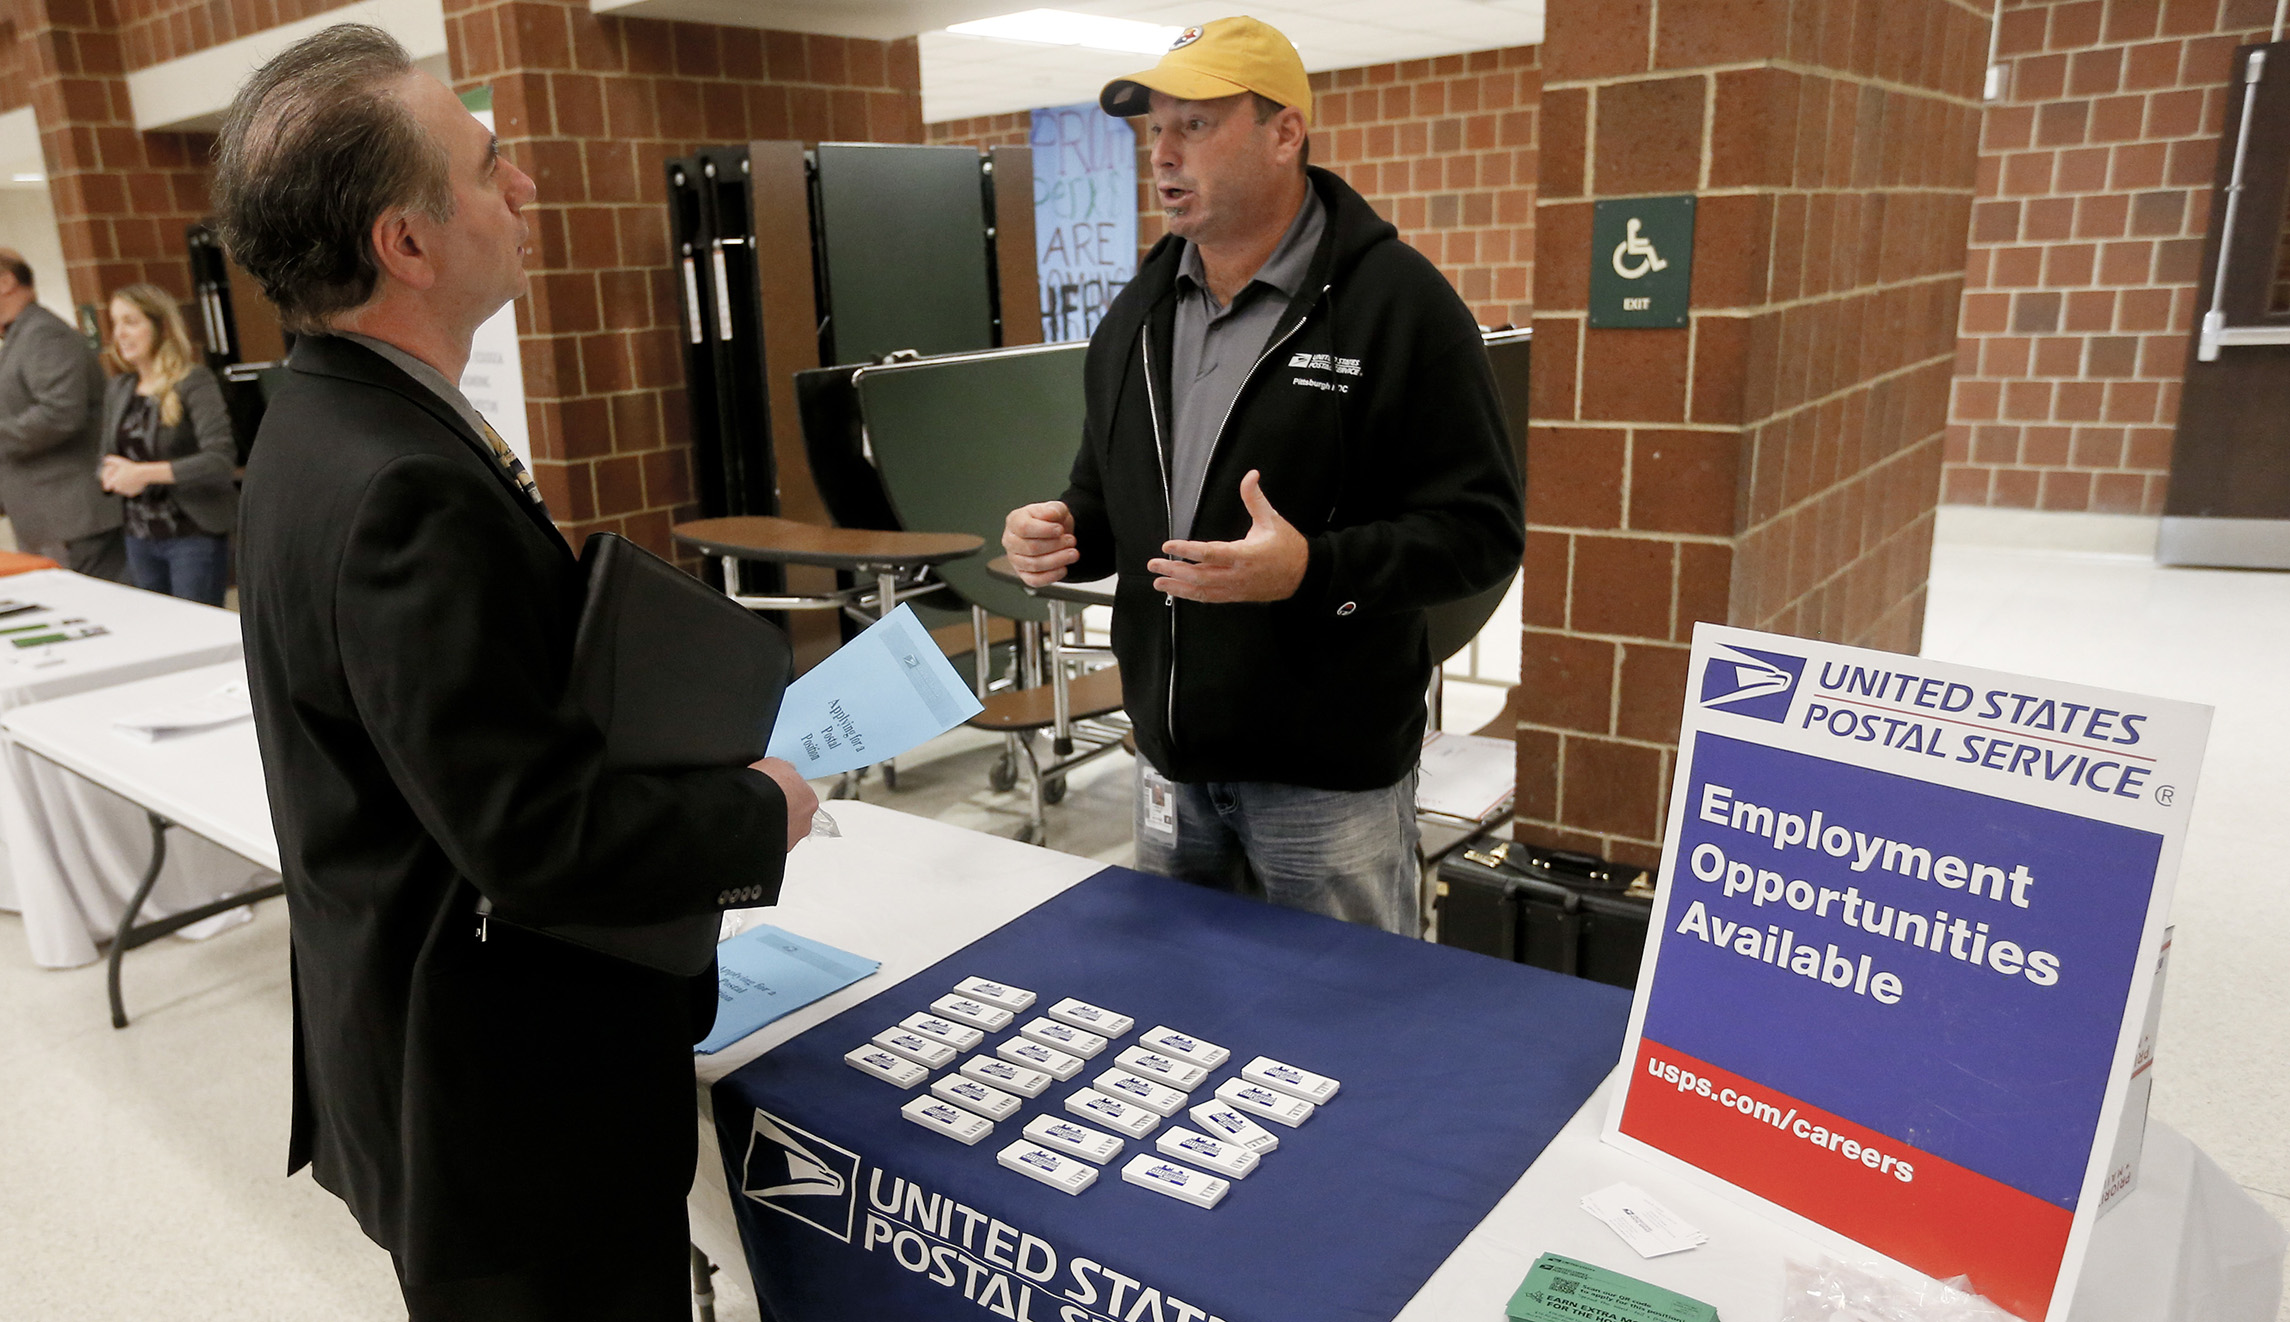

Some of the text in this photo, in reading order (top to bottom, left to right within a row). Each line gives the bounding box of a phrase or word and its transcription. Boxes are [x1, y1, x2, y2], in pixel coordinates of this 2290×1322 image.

[1042, 222, 1116, 268] ARE
[1623, 297, 1651, 311] EXIT
[1293, 378, 1330, 391] Pittsburgh
[828, 699, 855, 739] Applying
[850, 734, 862, 746] for
[1819, 661, 2147, 746] UNITED STATES
[801, 733, 820, 761] Position
[821, 725, 842, 750] Postal
[1802, 703, 1947, 758] POSTAL
[1956, 735, 2152, 800] SERVICE
[1699, 783, 2034, 909] Employment
[1690, 843, 2061, 987] Opportunities
[1676, 900, 1904, 1006] Available
[1647, 1056, 1915, 1183] usps.com/careers
[2098, 1172, 2131, 1208] PRIORI
[864, 1212, 1042, 1322] POSTAL
[868, 1167, 1227, 1322] UNITED STAT
[1546, 1295, 1578, 1308] EARN
[1580, 1304, 1618, 1320] EXTRA
[1546, 1301, 1570, 1312] FOR
[1572, 1308, 1594, 1318] THE
[1582, 1285, 1601, 1293] Scan
[1602, 1290, 1617, 1298] our
[1632, 1300, 1653, 1308] code
[1591, 1292, 1614, 1303] apply
[1630, 1303, 1646, 1311] this
